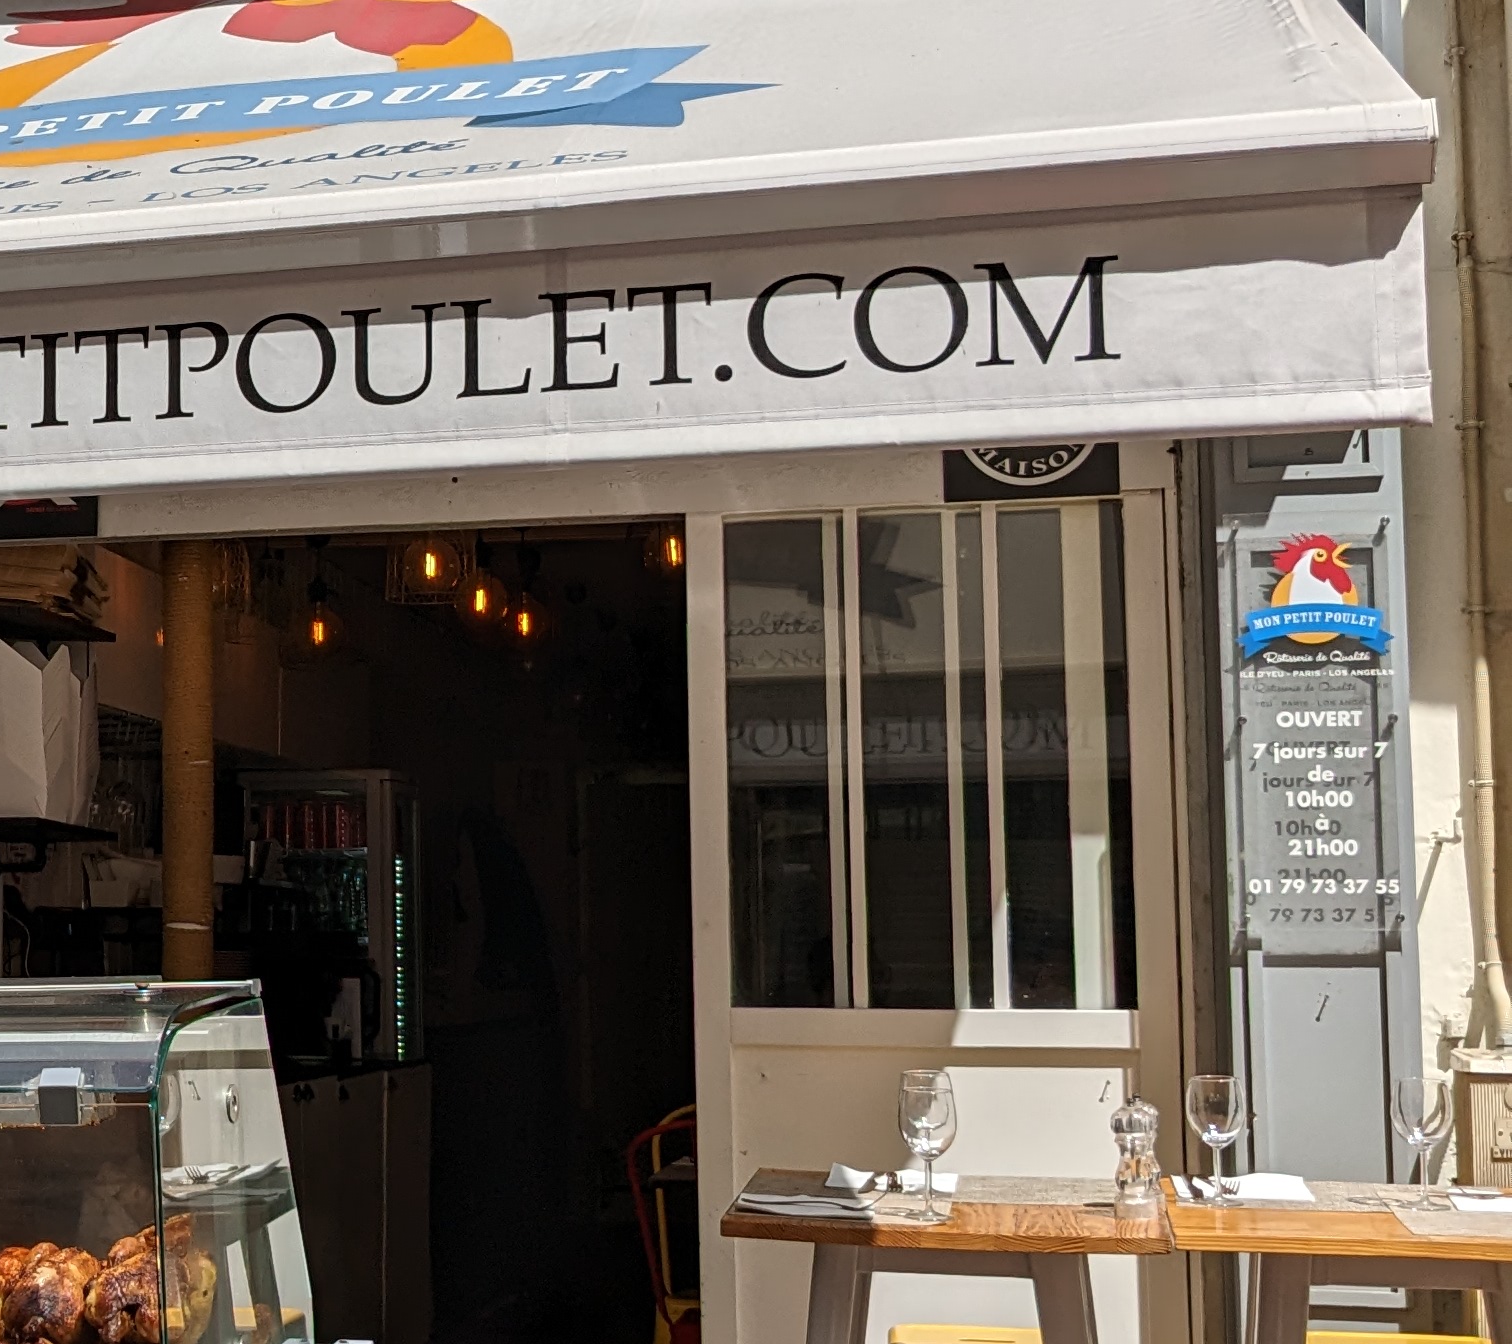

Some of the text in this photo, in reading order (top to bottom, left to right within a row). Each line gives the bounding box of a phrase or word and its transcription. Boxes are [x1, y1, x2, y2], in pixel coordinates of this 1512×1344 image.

[242, 67, 631, 115] POULET
[60, 164, 141, 186] de
[170, 138, 471, 176] Qualité
[139, 182, 268, 203] LOS
[290, 150, 630, 188] ANGELES
[1252, 611, 1377, 630] MON PETIT POULET
[1316, 652, 1328, 662] de
[1330, 650, 1371, 663] Qualité
[1257, 670, 1285, 678] D'YEU
[1292, 670, 1321, 678] PARIS
[1329, 669, 1348, 677] LOS
[1350, 668, 1395, 677] ANGELES
[1276, 710, 1363, 728] OUVERT
[1252, 742, 1266, 759] 7
[1273, 742, 1327, 764] jours
[1333, 745, 1368, 759] sur
[1374, 741, 1388, 758] 7
[1307, 764, 1335, 782] de
[1286, 790, 1354, 807] 10h00
[1315, 813, 1331, 831] à
[1288, 838, 1359, 856] 21h00
[1249, 879, 1400, 895] 01 79 73 37 55
